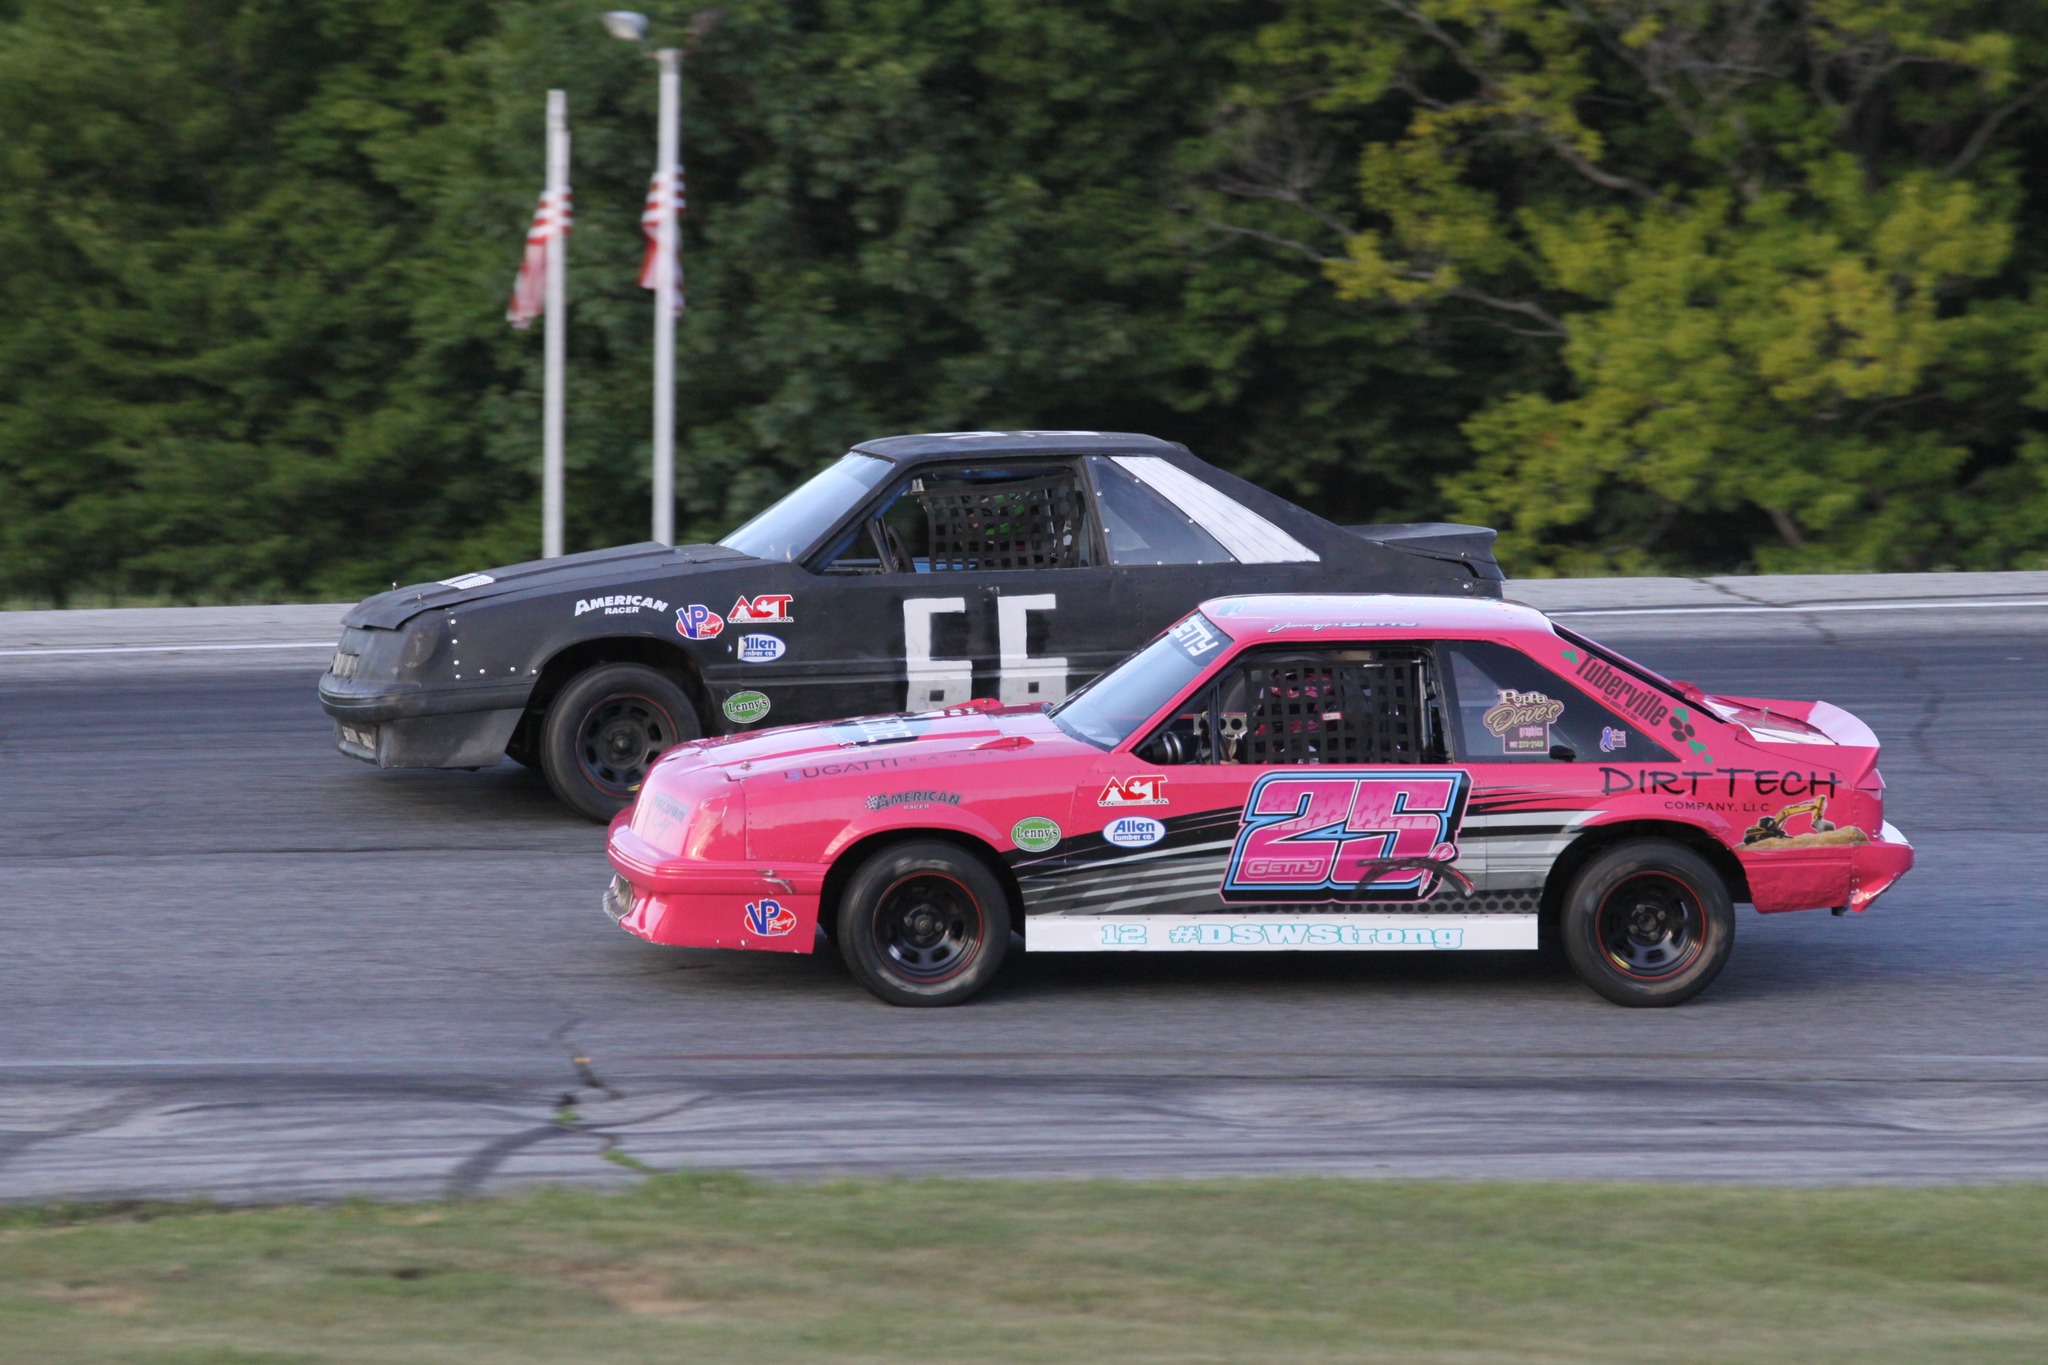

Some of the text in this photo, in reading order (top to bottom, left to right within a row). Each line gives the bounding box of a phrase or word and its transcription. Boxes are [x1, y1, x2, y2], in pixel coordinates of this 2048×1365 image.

[574, 595, 668, 616] AMERICAN
[727, 594, 794, 620] ACT
[675, 604, 709, 639] VP
[1576, 653, 1669, 727] Tuberville
[727, 698, 768, 714] Lenny's
[784, 757, 898, 783] BUGATTI
[1599, 766, 1842, 798] DIRT TECH
[875, 790, 961, 811] AMERICAN
[1098, 775, 1169, 801] ACT
[1664, 801, 1770, 813] COMPANY, LLC
[1016, 827, 1059, 841] Lenny's
[1113, 820, 1155, 833] Allen
[1114, 833, 1140, 842] lumber
[1224, 772, 1463, 893] 25
[1248, 860, 1322, 874] GETTY
[744, 899, 780, 936] VP
[1101, 923, 1464, 950] 12 #DSWStrong
